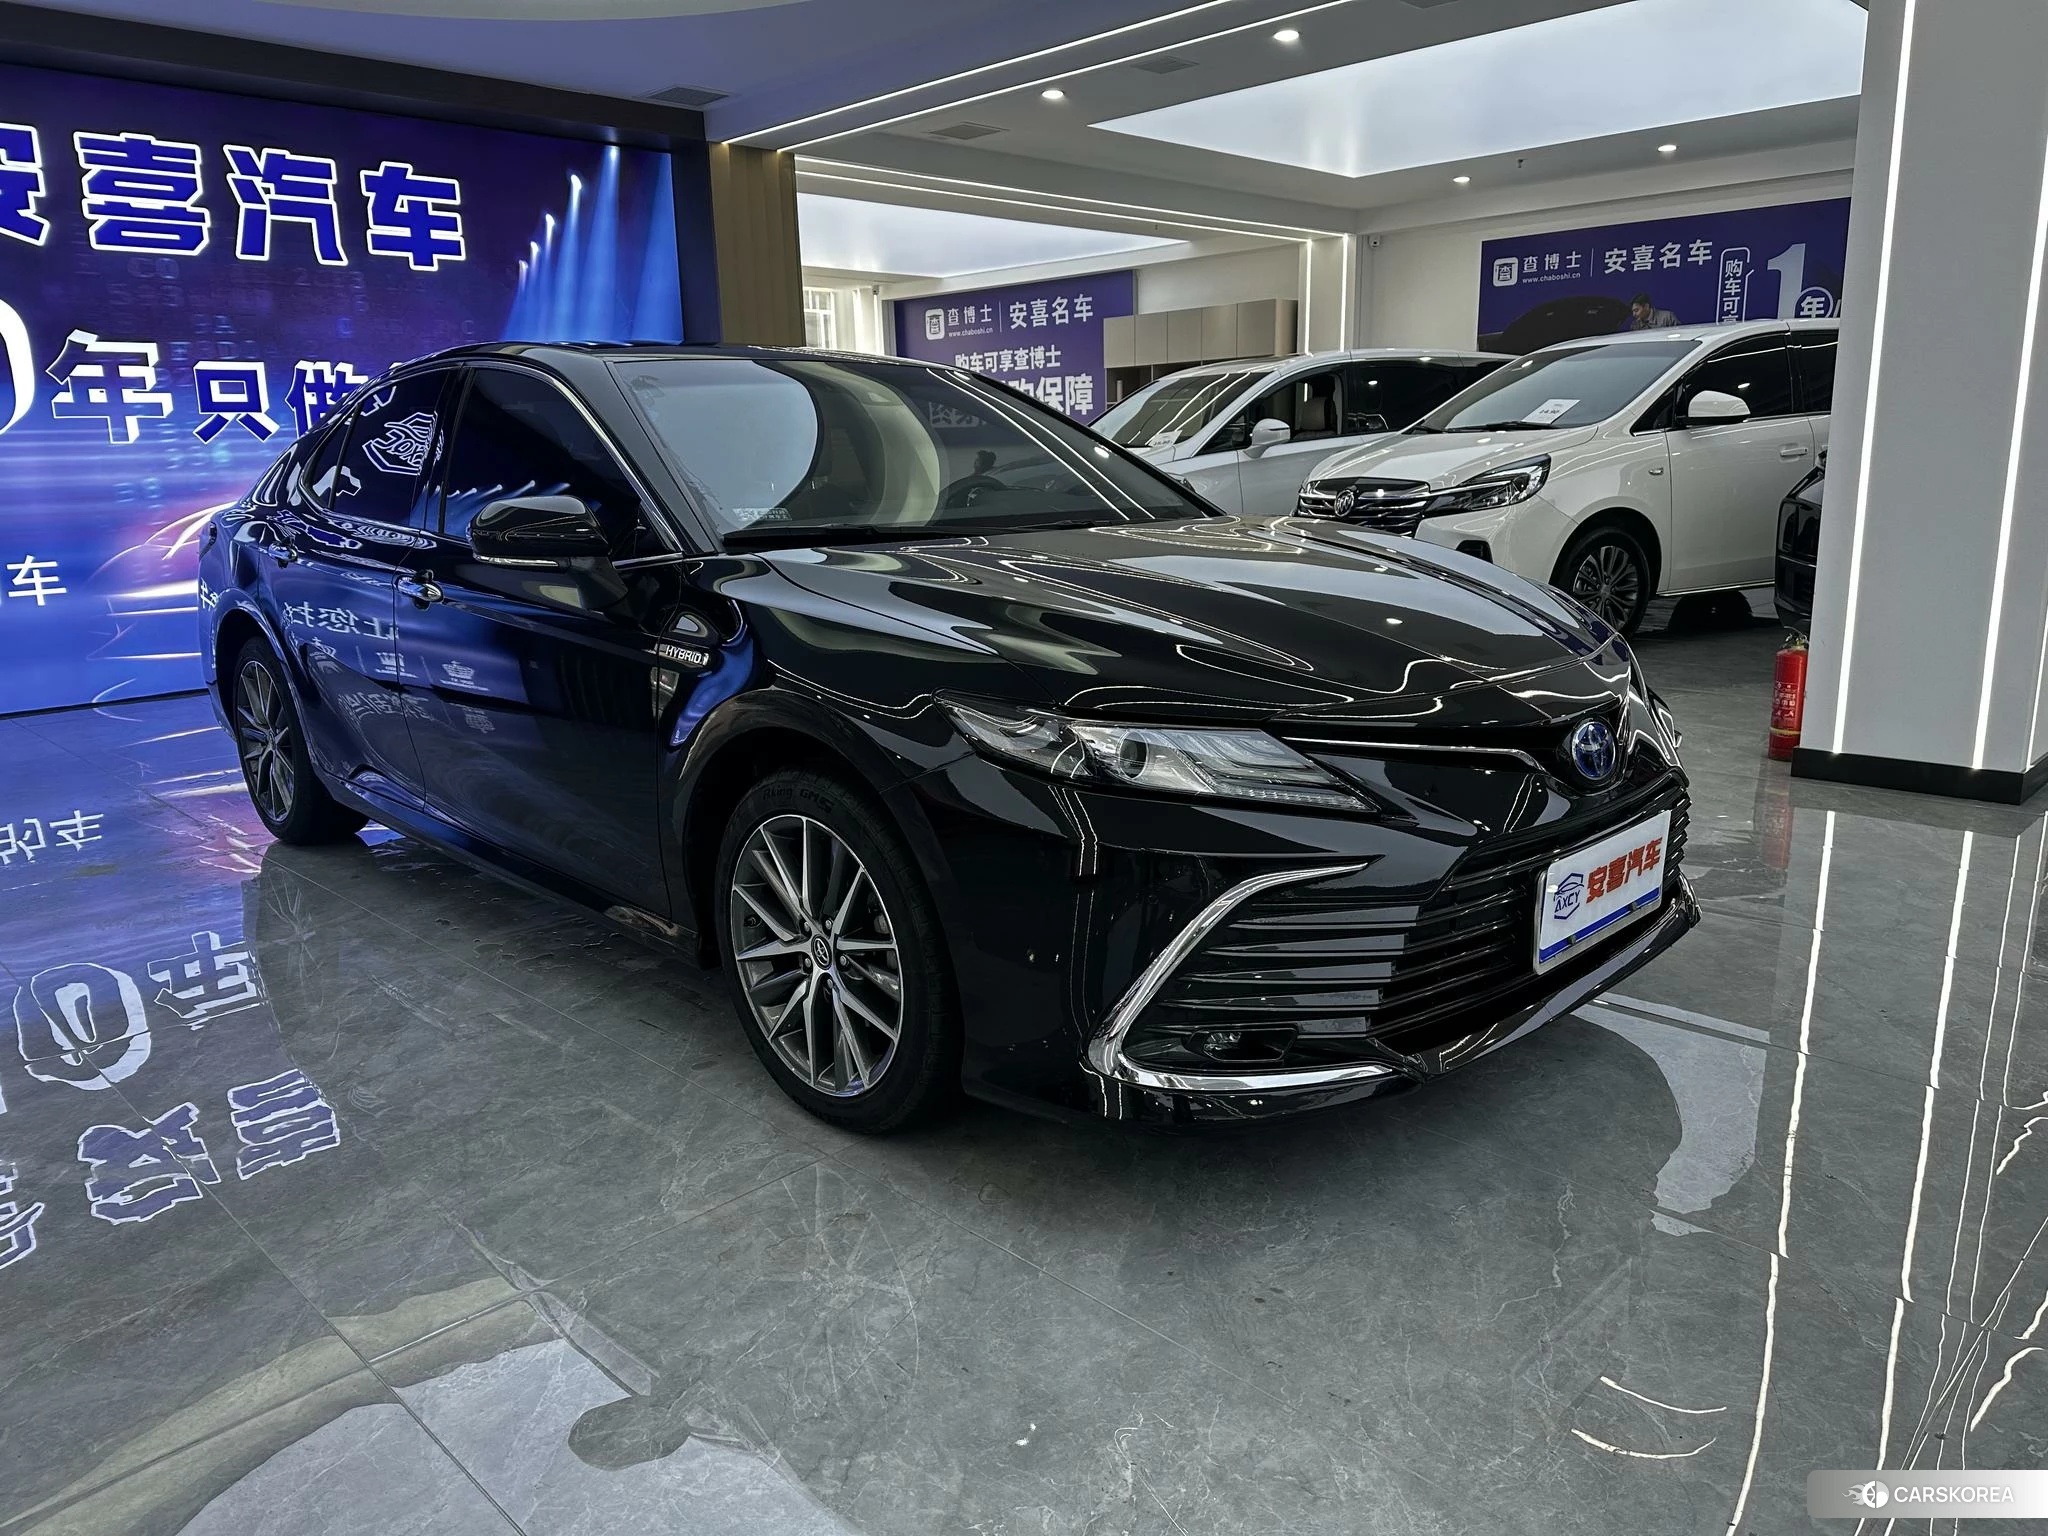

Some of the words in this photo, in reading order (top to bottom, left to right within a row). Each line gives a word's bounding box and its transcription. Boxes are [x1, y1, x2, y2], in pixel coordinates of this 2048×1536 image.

[1522, 251, 1582, 273] 查博士
[1604, 239, 1713, 274] 安喜名车
[1522, 272, 1581, 284] www.chaboshi.cn
[947, 304, 993, 326] 查博士
[1009, 294, 1094, 329] 安喜名车
[949, 327, 993, 338] www.chaboshi.cn
[955, 345, 1062, 373] 购车可享查博士
[7, 555, 67, 606] 车
[666, 644, 702, 664] HYBRID
[1585, 837, 1663, 903] 安喜汽车
